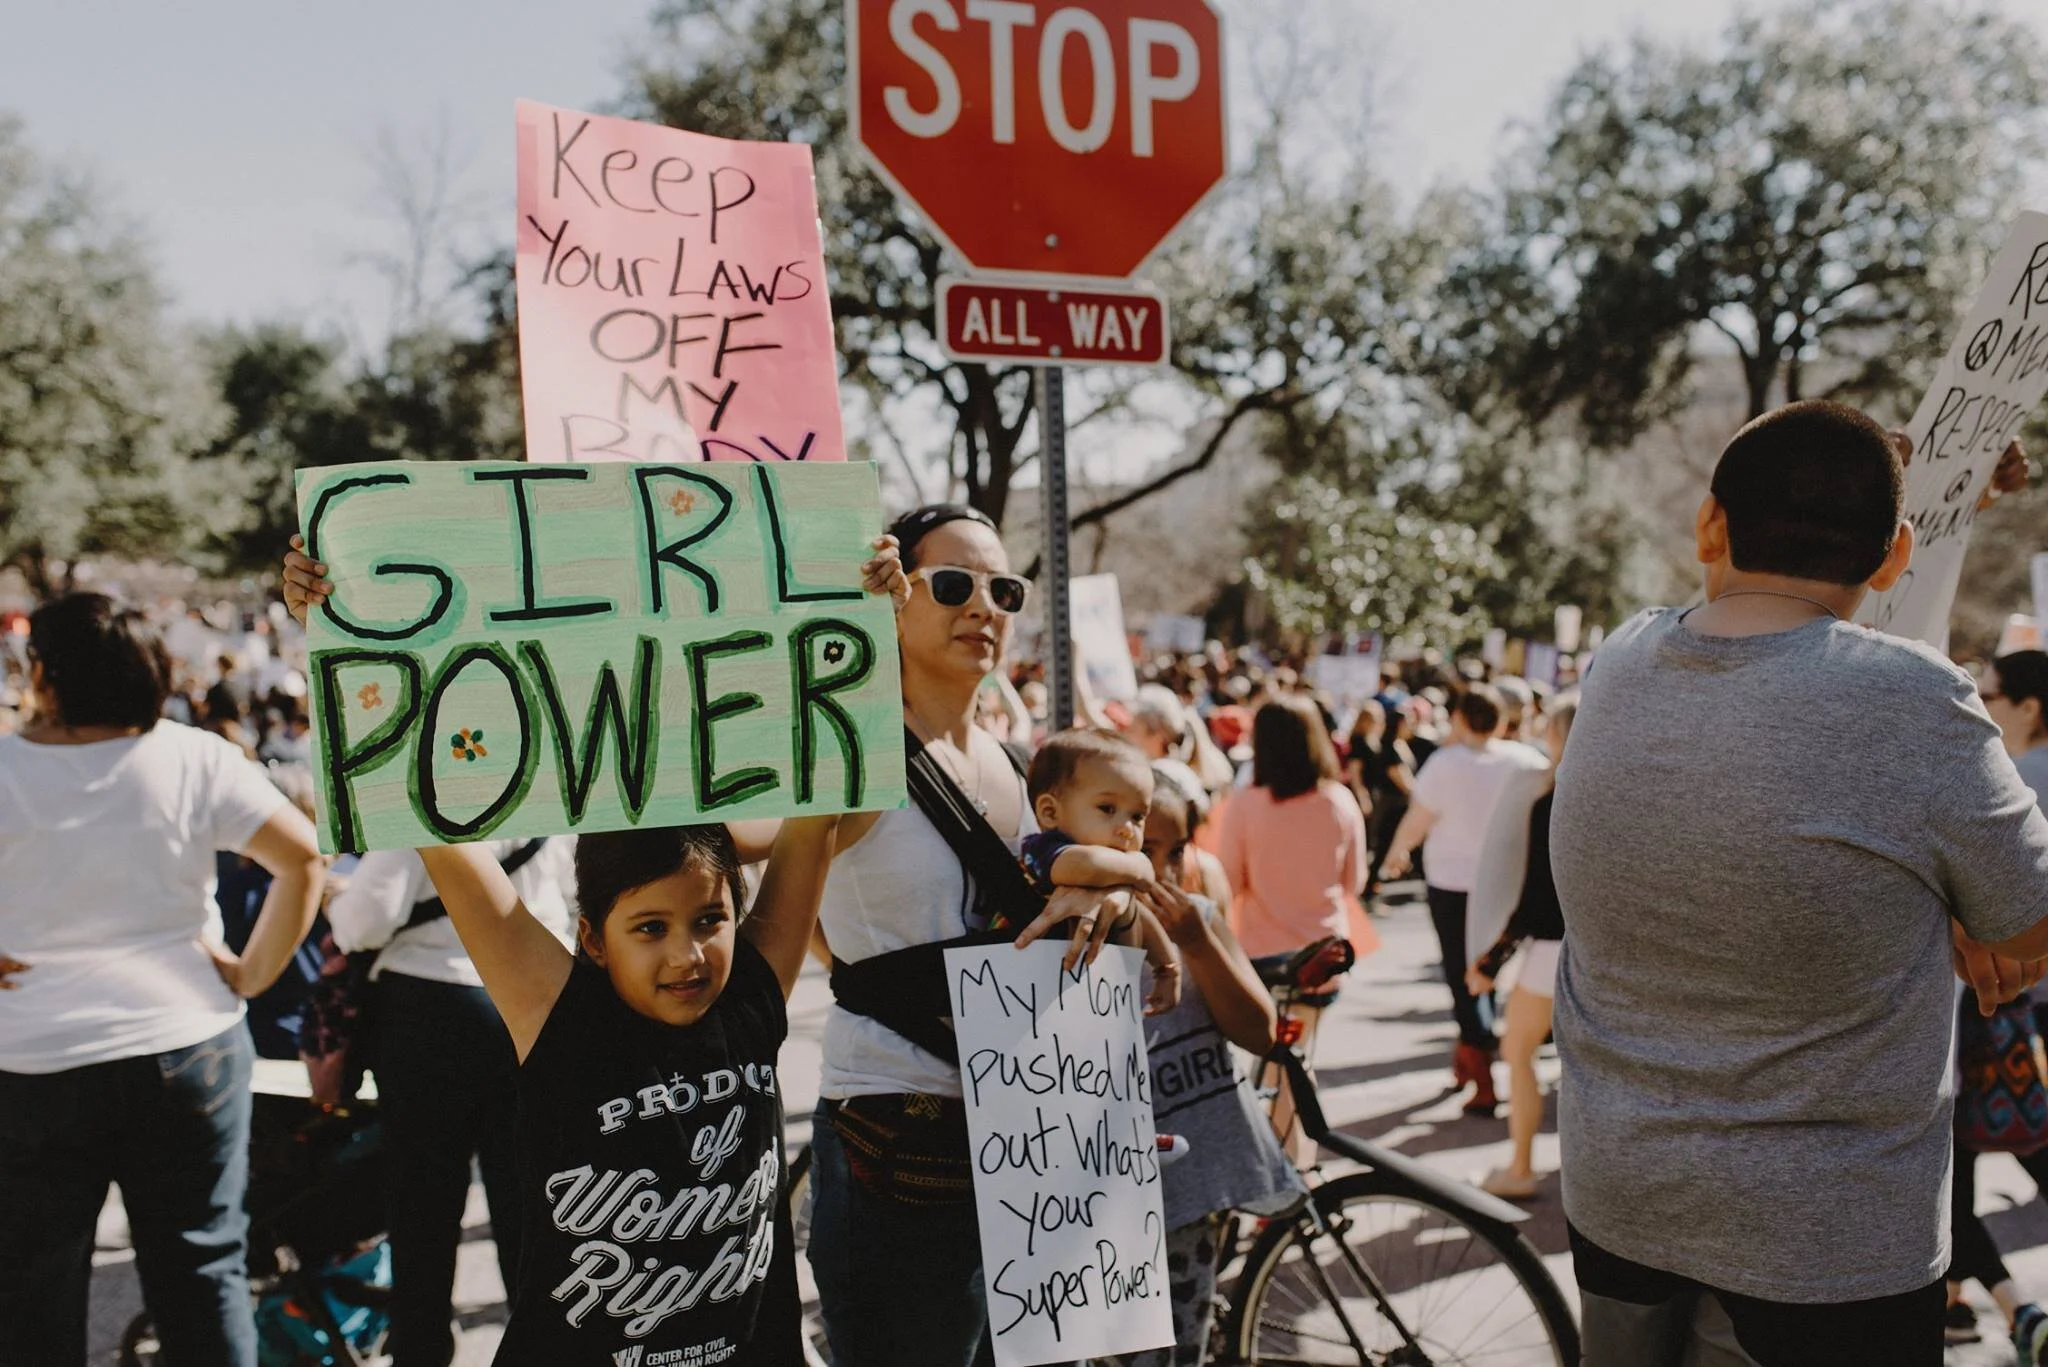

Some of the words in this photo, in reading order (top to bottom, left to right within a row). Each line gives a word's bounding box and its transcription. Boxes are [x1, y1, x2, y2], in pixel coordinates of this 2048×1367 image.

[884, 0, 1200, 158] STOP
[553, 111, 756, 244] Keep
[590, 308, 783, 379] OFF
[962, 297, 1041, 346] ALL
[1067, 302, 1148, 352] WAY
[618, 372, 740, 432] MY
[307, 463, 864, 641] GIRL
[309, 617, 877, 855] POWER
[961, 959, 1039, 1039] My
[1059, 951, 1137, 1025] Mom
[688, 1104, 747, 1181] of
[979, 1107, 1061, 1177] out.
[1066, 1109, 1158, 1187] What's
[645, 1349, 683, 1366] CENTER
[684, 1344, 703, 1359] FOR
[704, 1336, 726, 1353] CIVIL
